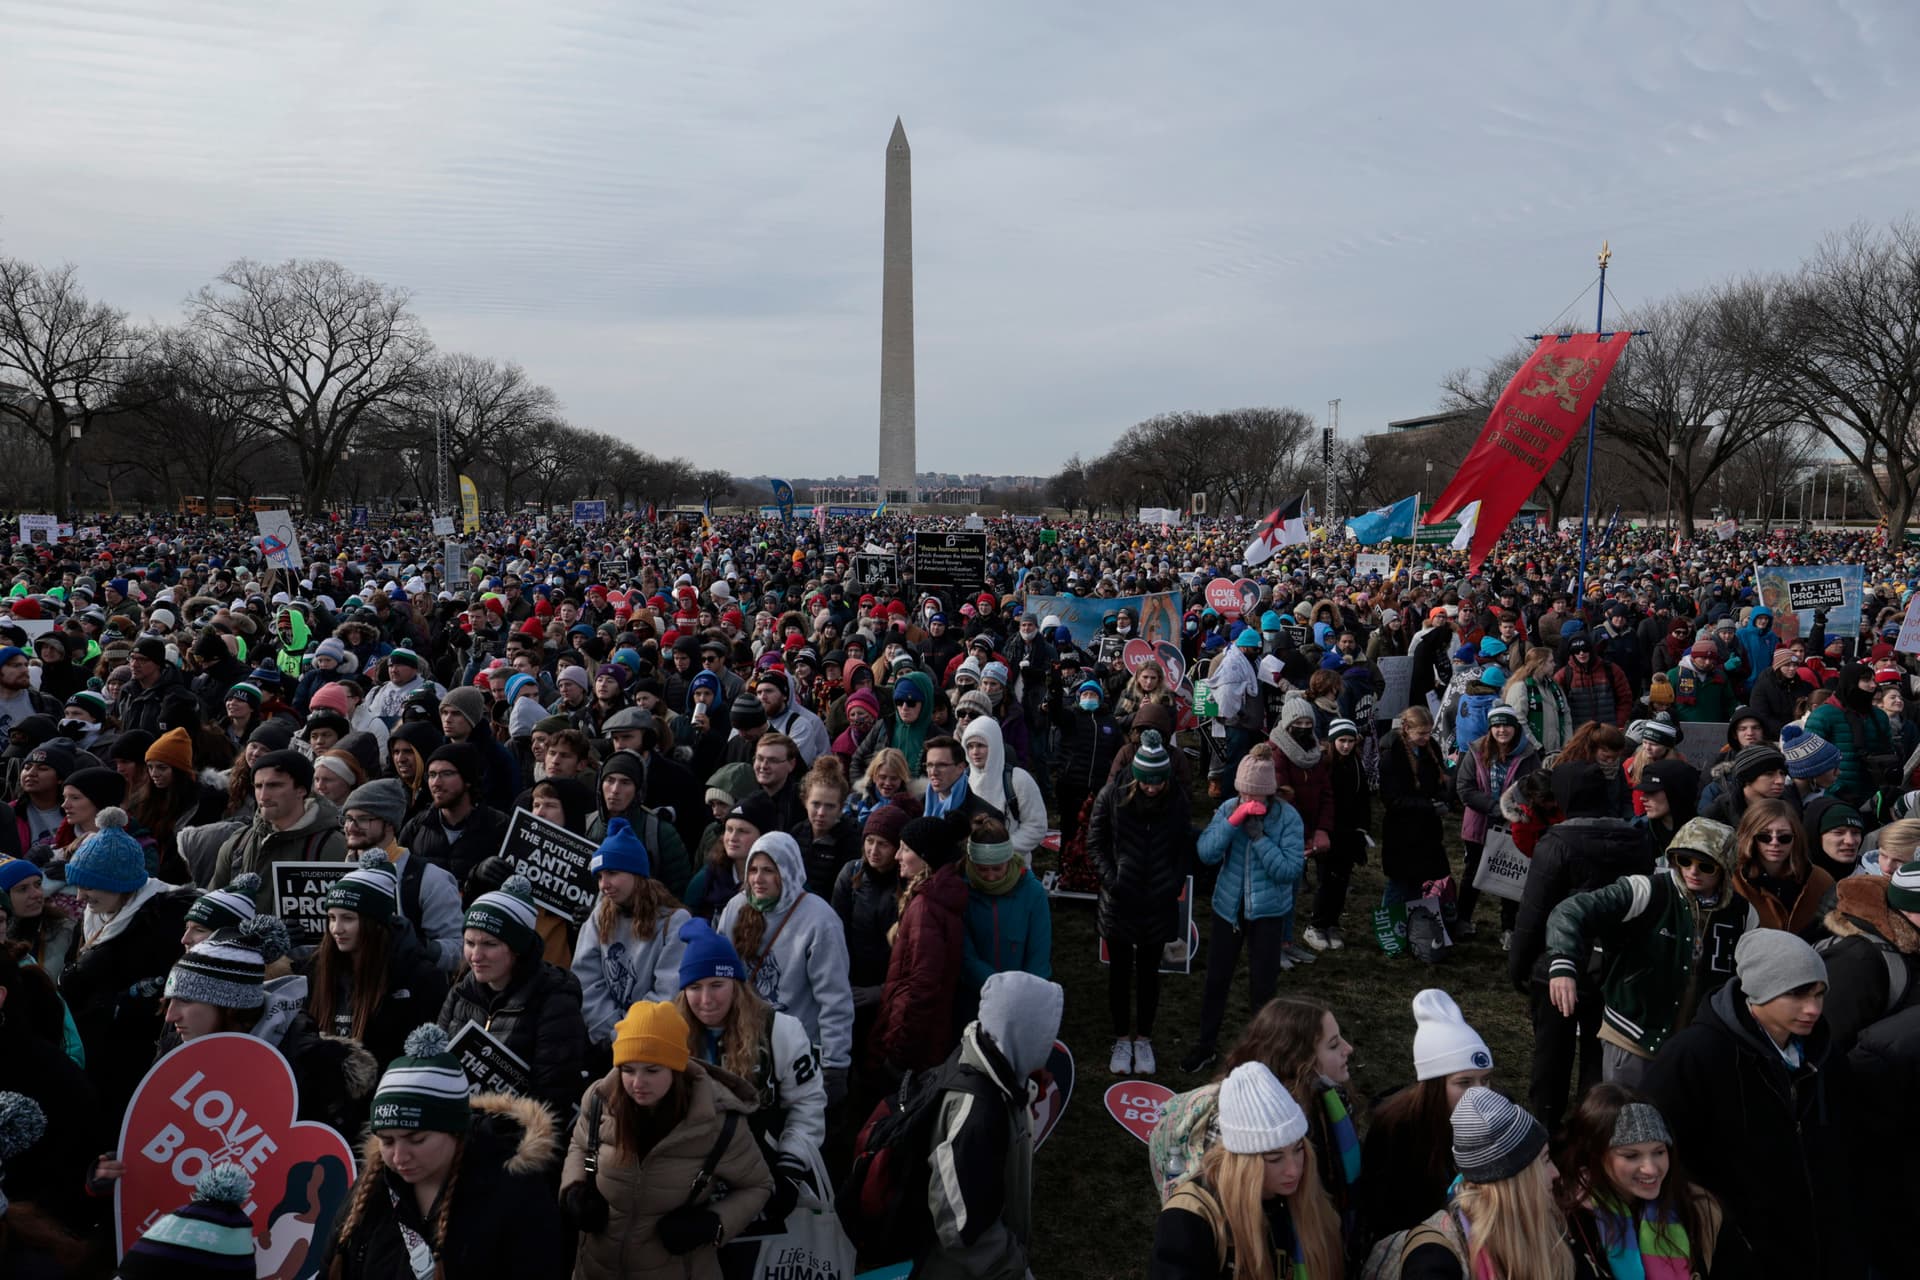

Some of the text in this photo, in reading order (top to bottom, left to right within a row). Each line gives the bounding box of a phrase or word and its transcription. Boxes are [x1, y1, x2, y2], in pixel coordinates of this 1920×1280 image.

[1211, 588, 1235, 598] LOVE
[1791, 588, 1841, 600] PRO-LIFE
[1819, 582, 1838, 590] THE
[1215, 599, 1240, 607] BOTH
[1793, 596, 1842, 606] GENERATION
[519, 827, 587, 869] THE FUTURE
[527, 848, 578, 879] ANTI-
[1487, 856, 1528, 875] HUMAN
[505, 854, 595, 907] ABORTION
[1489, 864, 1522, 881] RIGHT
[287, 880, 293, 893] I
[1374, 907, 1393, 930] LIFE
[460, 1049, 491, 1079] THE
[486, 1073, 521, 1097] FUT
[1120, 1092, 1165, 1110] LOV
[169, 1070, 279, 1175] LOVE
[1124, 1108, 1160, 1124] BO
[777, 1248, 832, 1272] Life is a
[765, 1266, 841, 1280] HUMAN
